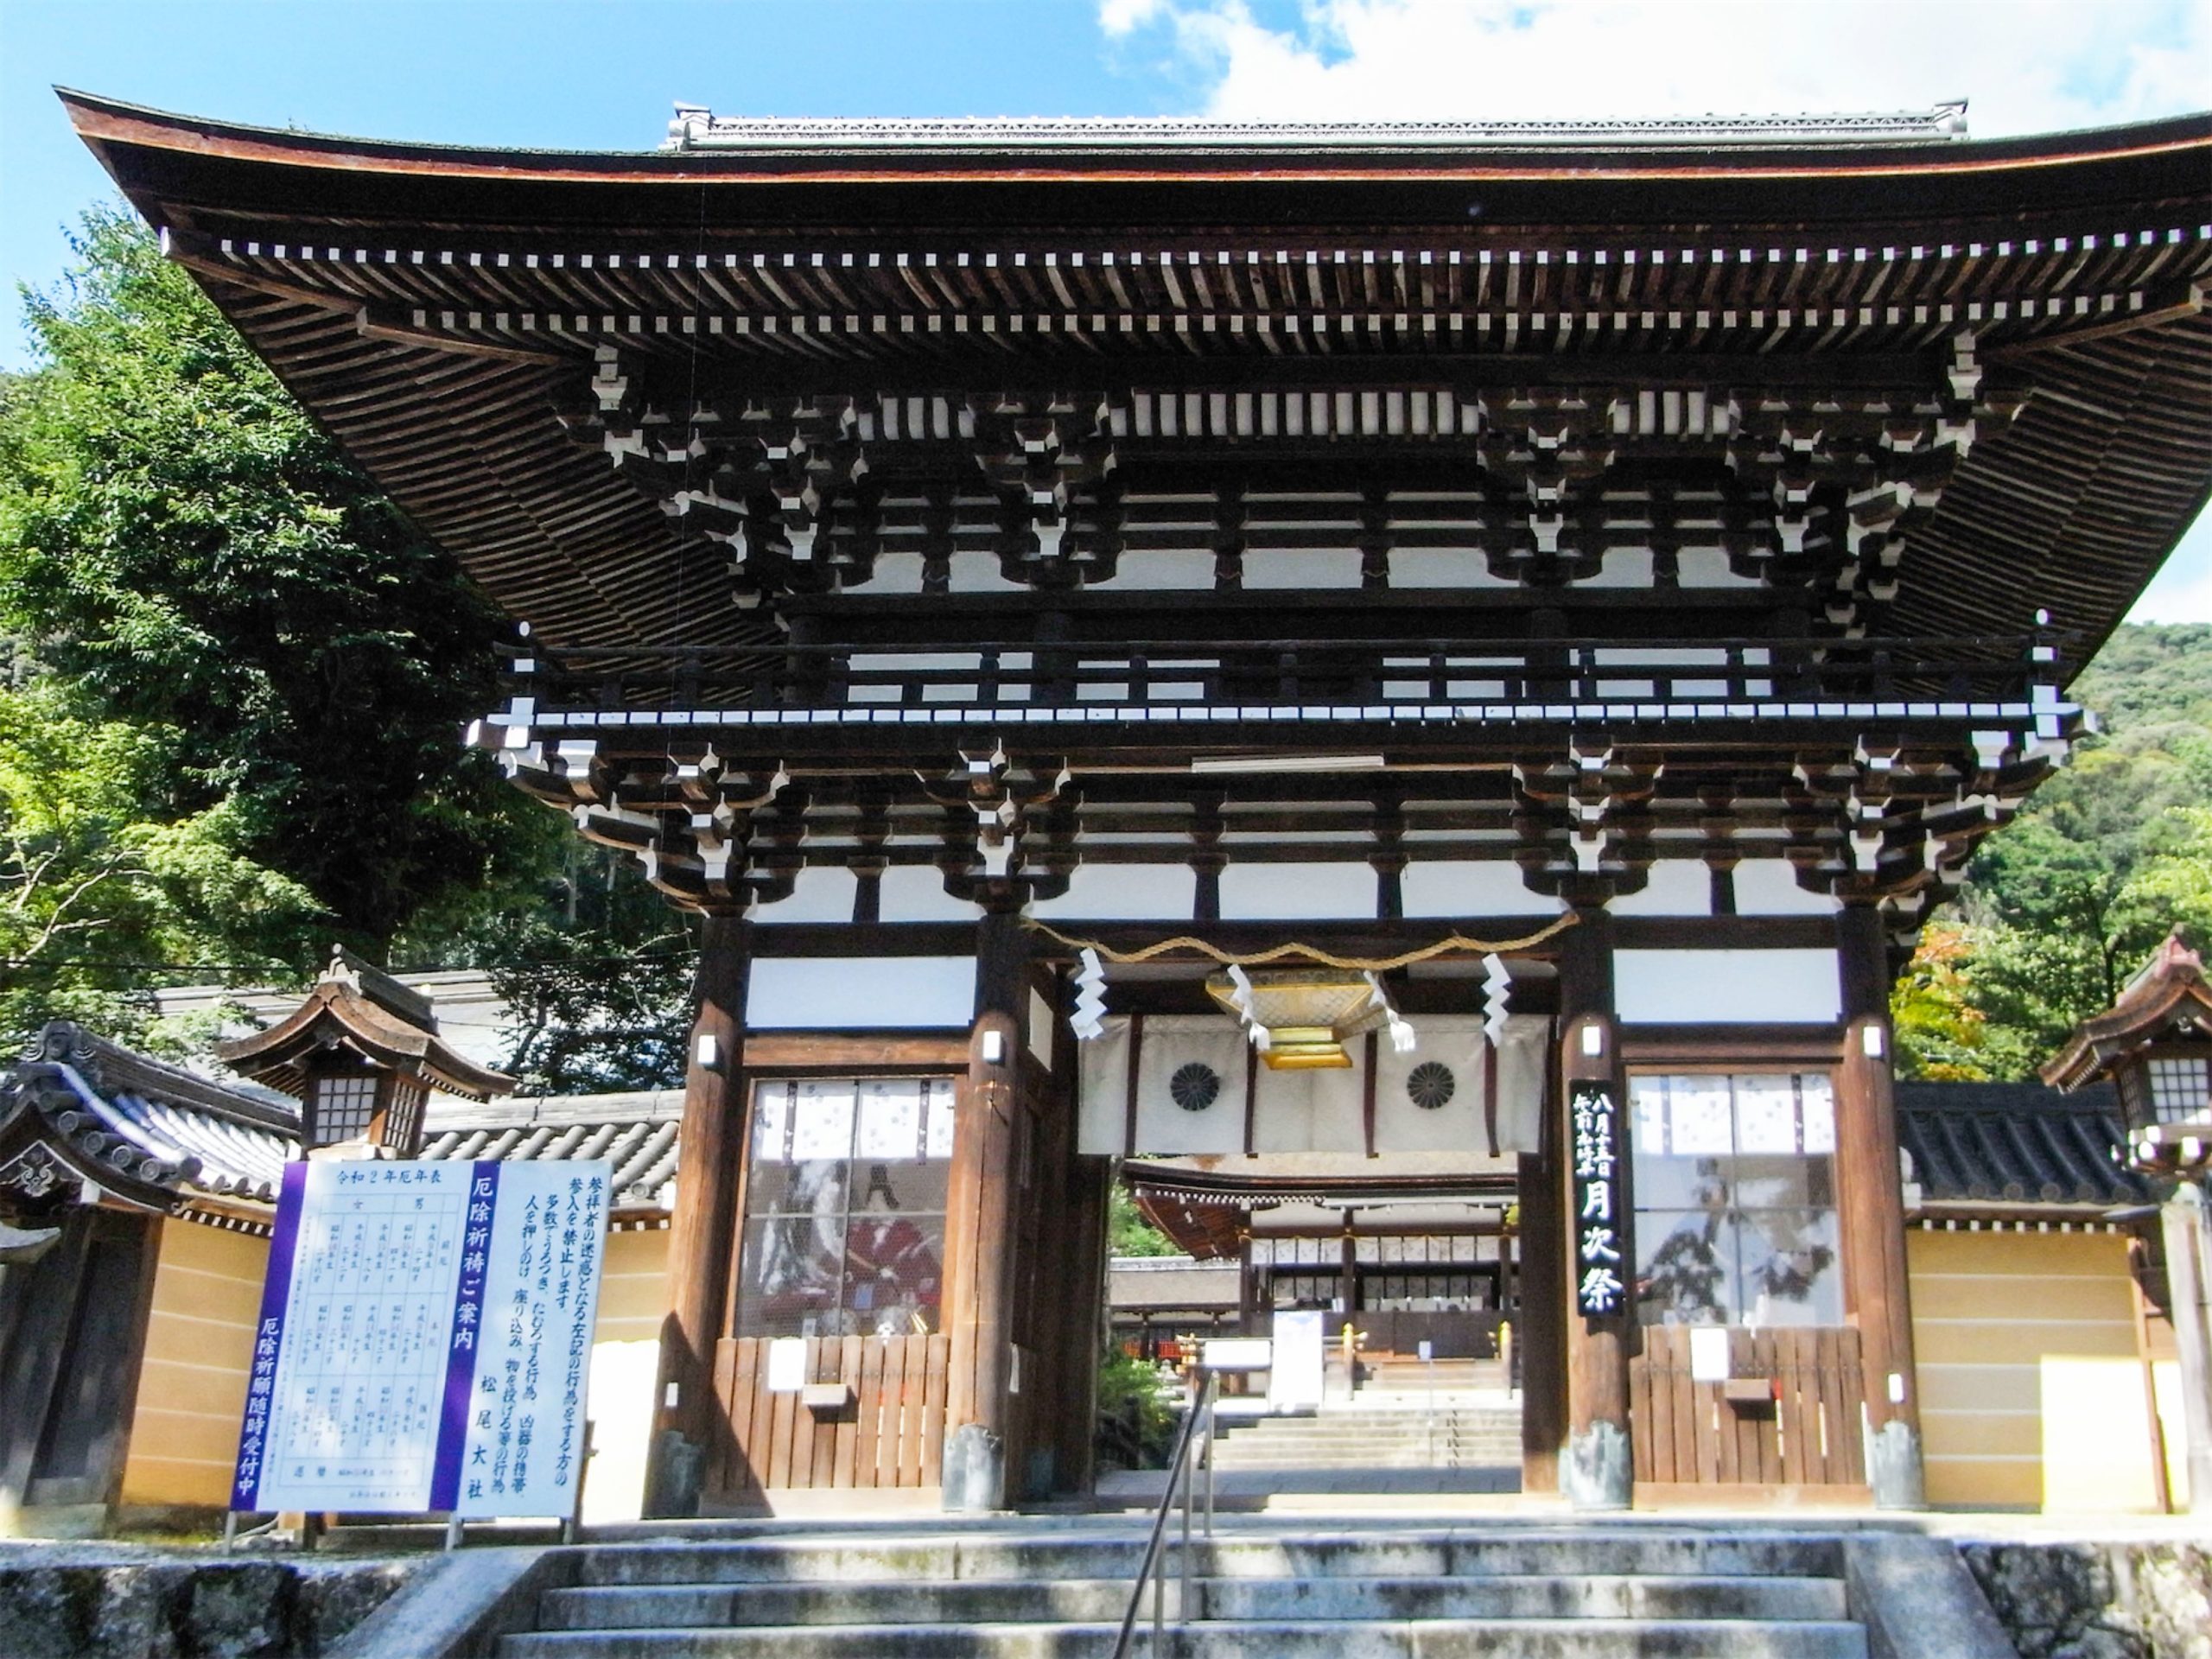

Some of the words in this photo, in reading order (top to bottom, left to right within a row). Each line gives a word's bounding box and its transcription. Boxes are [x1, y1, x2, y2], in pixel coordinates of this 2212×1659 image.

[337, 1169, 442, 1185] 令和2年厄年表
[454, 1177, 493, 1350] 厄除祈祷ご案内
[1580, 1180, 1622, 1311] 月次祭
[238, 1317, 279, 1497] 厄除祈願随時受付中
[467, 1375, 497, 1499] 松尾大社
